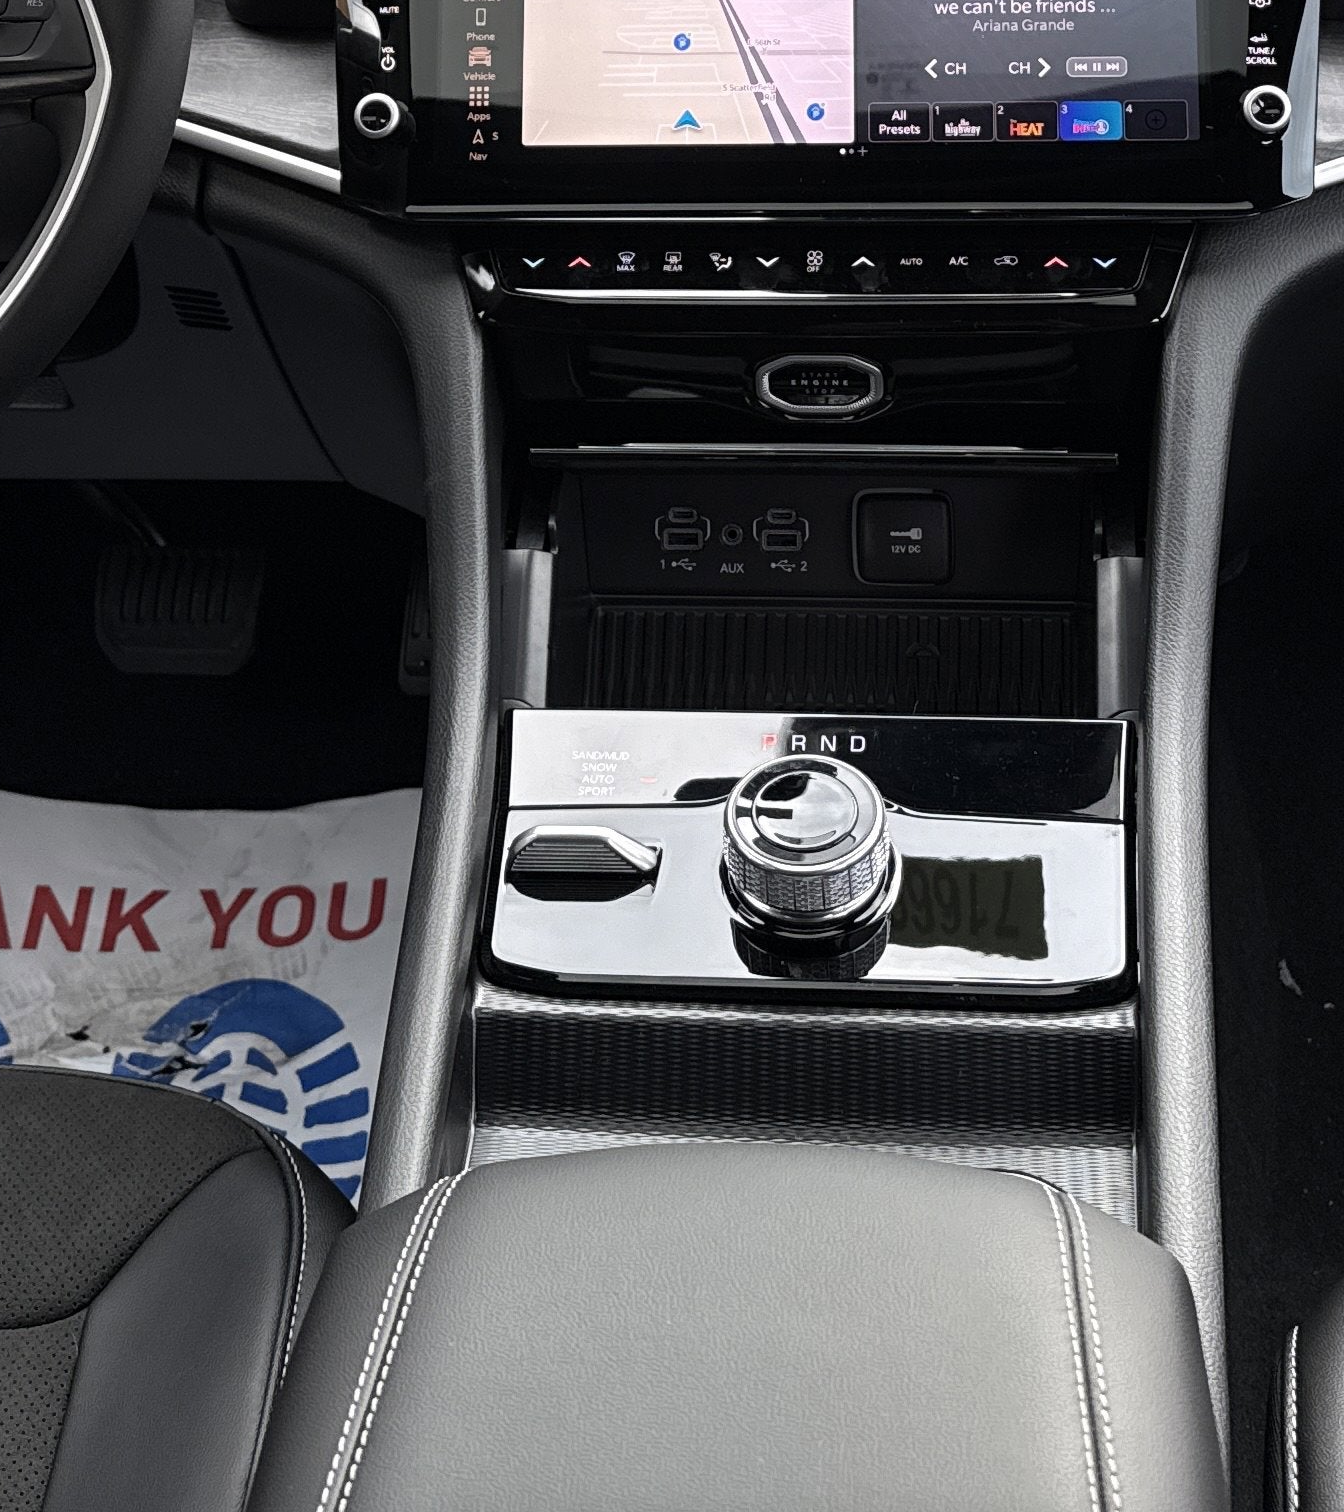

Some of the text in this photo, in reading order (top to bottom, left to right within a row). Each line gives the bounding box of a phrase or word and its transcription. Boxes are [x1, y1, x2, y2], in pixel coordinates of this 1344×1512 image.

[379, 6, 400, 14] MUTE
[934, 2, 959, 15] we
[962, 0, 1006, 15] can't
[972, 18, 1075, 32] Ariana Grande
[466, 32, 495, 41] Phone
[381, 46, 395, 54] VOL
[1246, 57, 1277, 65] SCROLL
[945, 62, 967, 76] CH
[1008, 61, 1031, 75] CH
[463, 72, 496, 81] Vehicle
[934, 106, 940, 115] 1
[997, 105, 1004, 115] 2
[1060, 105, 1068, 115] 3
[1125, 104, 1133, 114] 4
[467, 112, 491, 122] Apps
[891, 109, 907, 121] All
[879, 124, 921, 136] Presets
[945, 123, 981, 137] highway
[1010, 123, 1044, 136] HEAT
[492, 132, 499, 141] S
[469, 152, 488, 161] Nav
[900, 258, 923, 266] AUTO
[949, 257, 969, 266] A/C
[891, 545, 921, 554] 12V DC
[720, 563, 745, 574] AUX
[800, 561, 808, 572] 2
[761, 733, 866, 753] P R N D
[572, 750, 630, 761] SAND/MUD
[581, 762, 618, 772] SNOW
[581, 774, 615, 785] AUTO
[577, 786, 616, 797] SPORT
[198, 877, 388, 951] YOU
